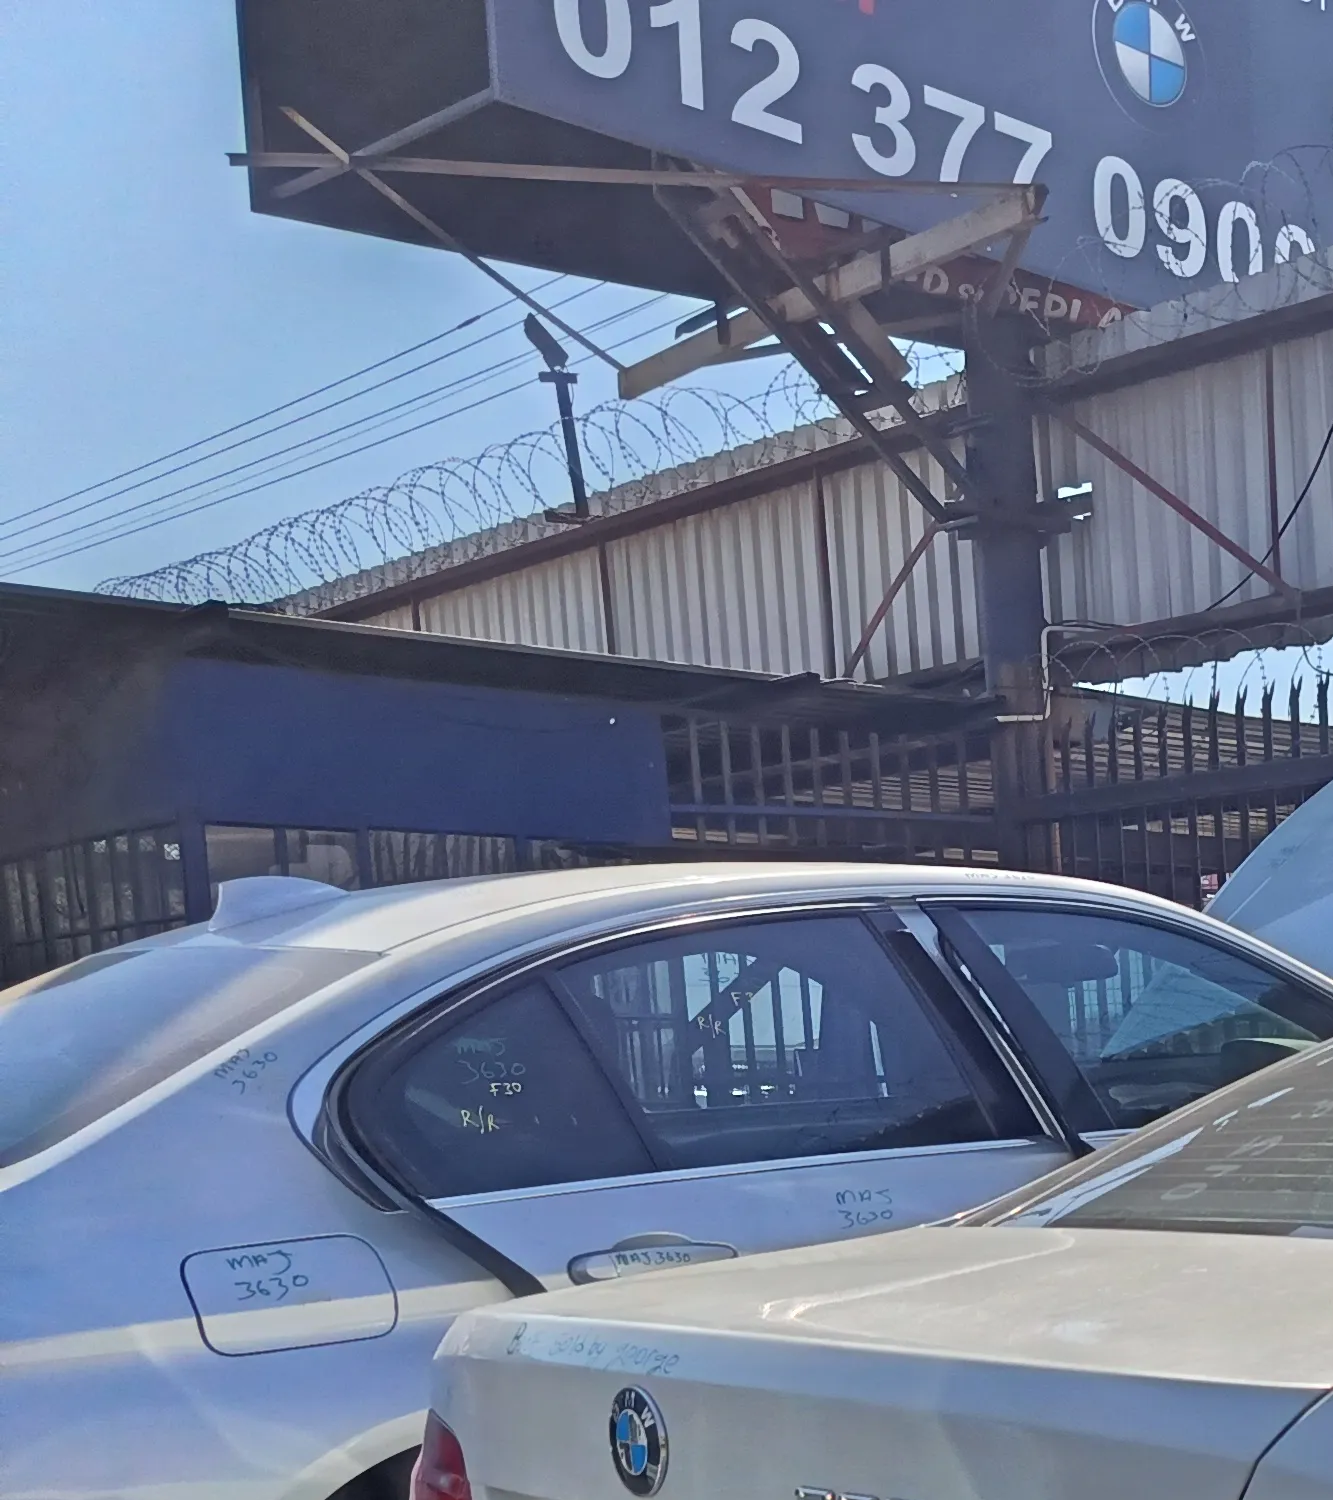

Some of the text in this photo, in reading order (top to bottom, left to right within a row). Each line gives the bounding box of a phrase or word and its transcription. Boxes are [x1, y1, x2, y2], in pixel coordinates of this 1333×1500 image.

[553, 0, 802, 144] 012
[851, 63, 1052, 184] 377
[231, 1051, 278, 1095] 3630
[457, 1059, 527, 1085] 3630
[489, 1082, 522, 1097] F30
[460, 1105, 500, 1134] R/R
[234, 1274, 309, 1301] 3630
